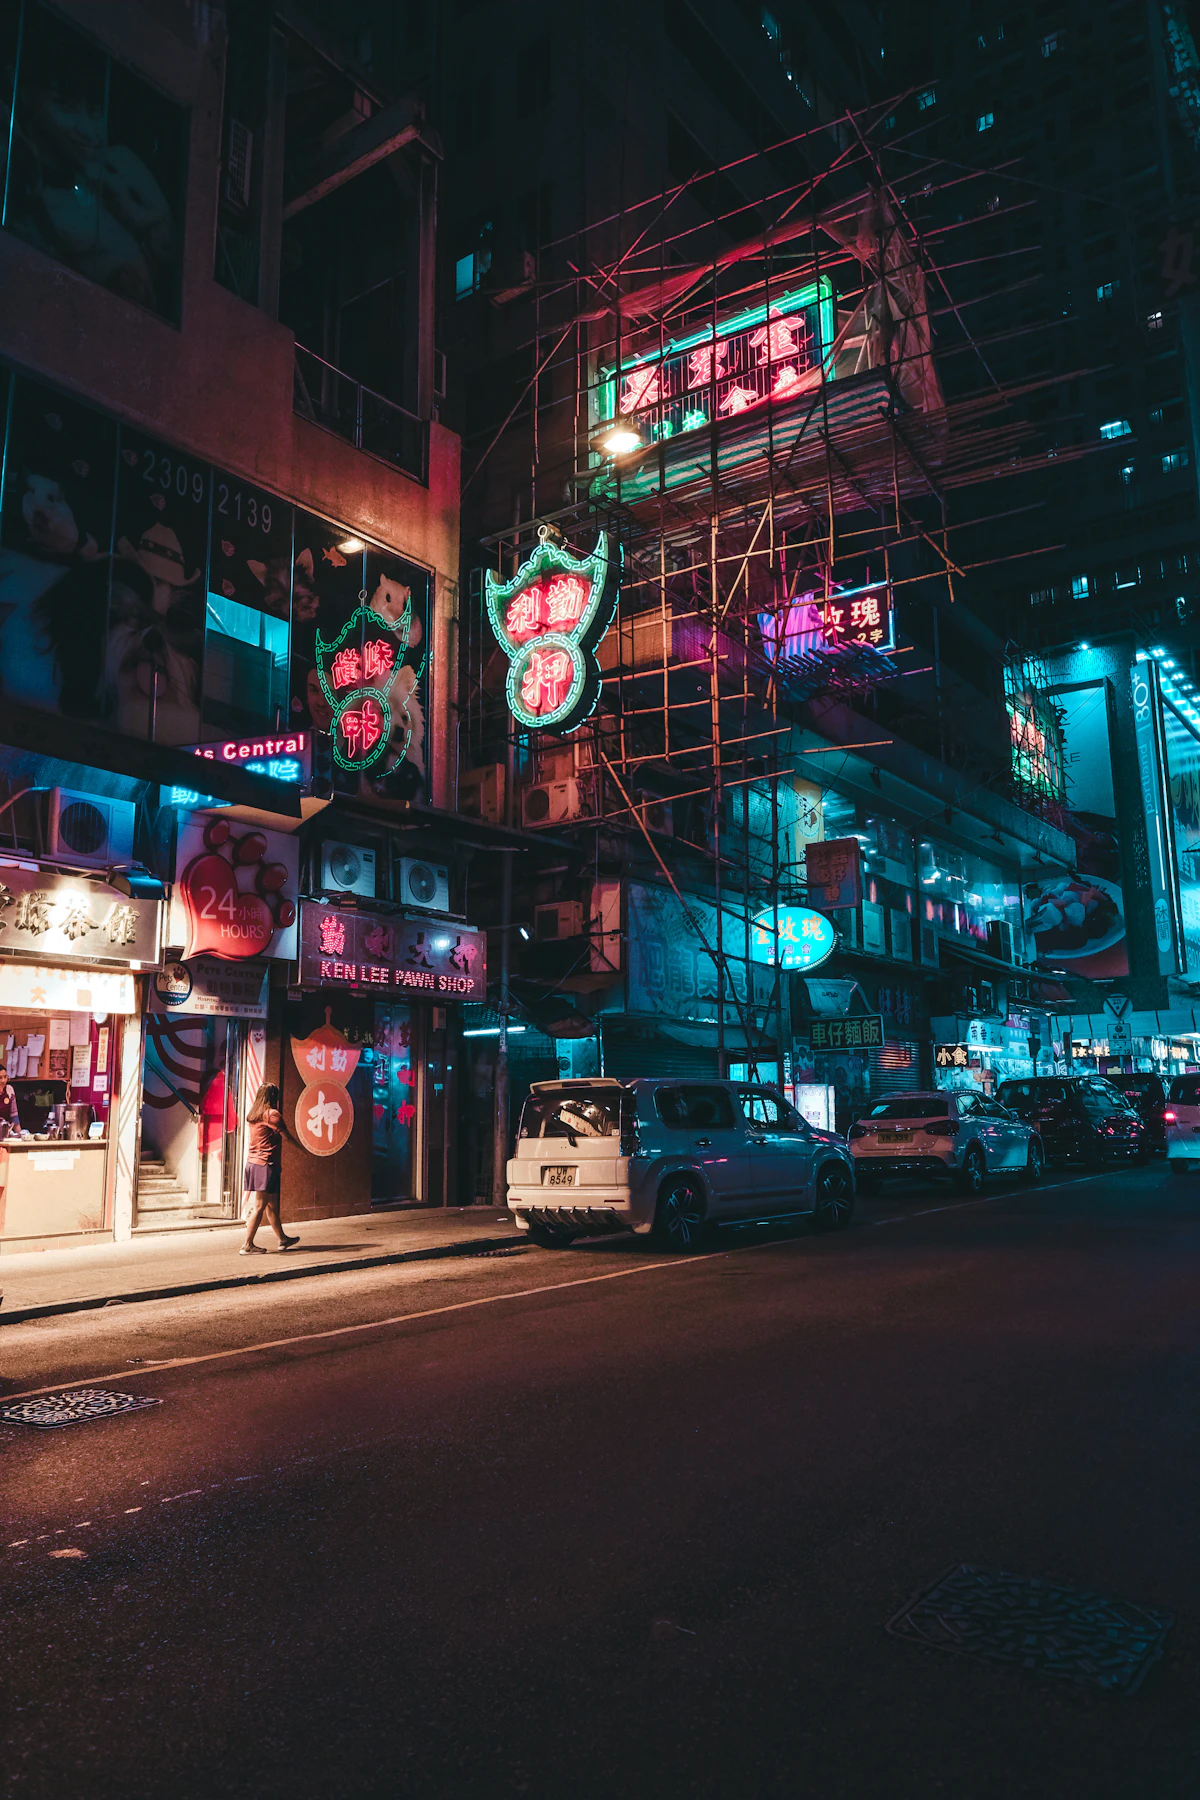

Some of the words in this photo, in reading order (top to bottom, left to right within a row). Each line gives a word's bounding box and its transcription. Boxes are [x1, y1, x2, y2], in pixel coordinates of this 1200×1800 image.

[143, 450, 203, 503] 2309
[217, 484, 272, 534] 2139
[522, 652, 569, 707] 押
[222, 734, 304, 760] Central
[200, 886, 237, 920] 24
[239, 906, 264, 921] 小時
[220, 924, 264, 939] HOURS
[752, 915, 824, 944] 金玫瑰
[318, 915, 478, 975] 勤利大押
[158, 972, 173, 983] Pets
[165, 982, 188, 992] Central
[319, 961, 356, 980] KEN
[360, 965, 390, 984] LEE
[395, 969, 435, 989] PAWN
[438, 974, 475, 993] SHOP
[811, 1019, 880, 1047] 車仔麵飯
[937, 1047, 968, 1066] 小食
[307, 1090, 343, 1144] 押
[550, 1175, 573, 1184] 8549
